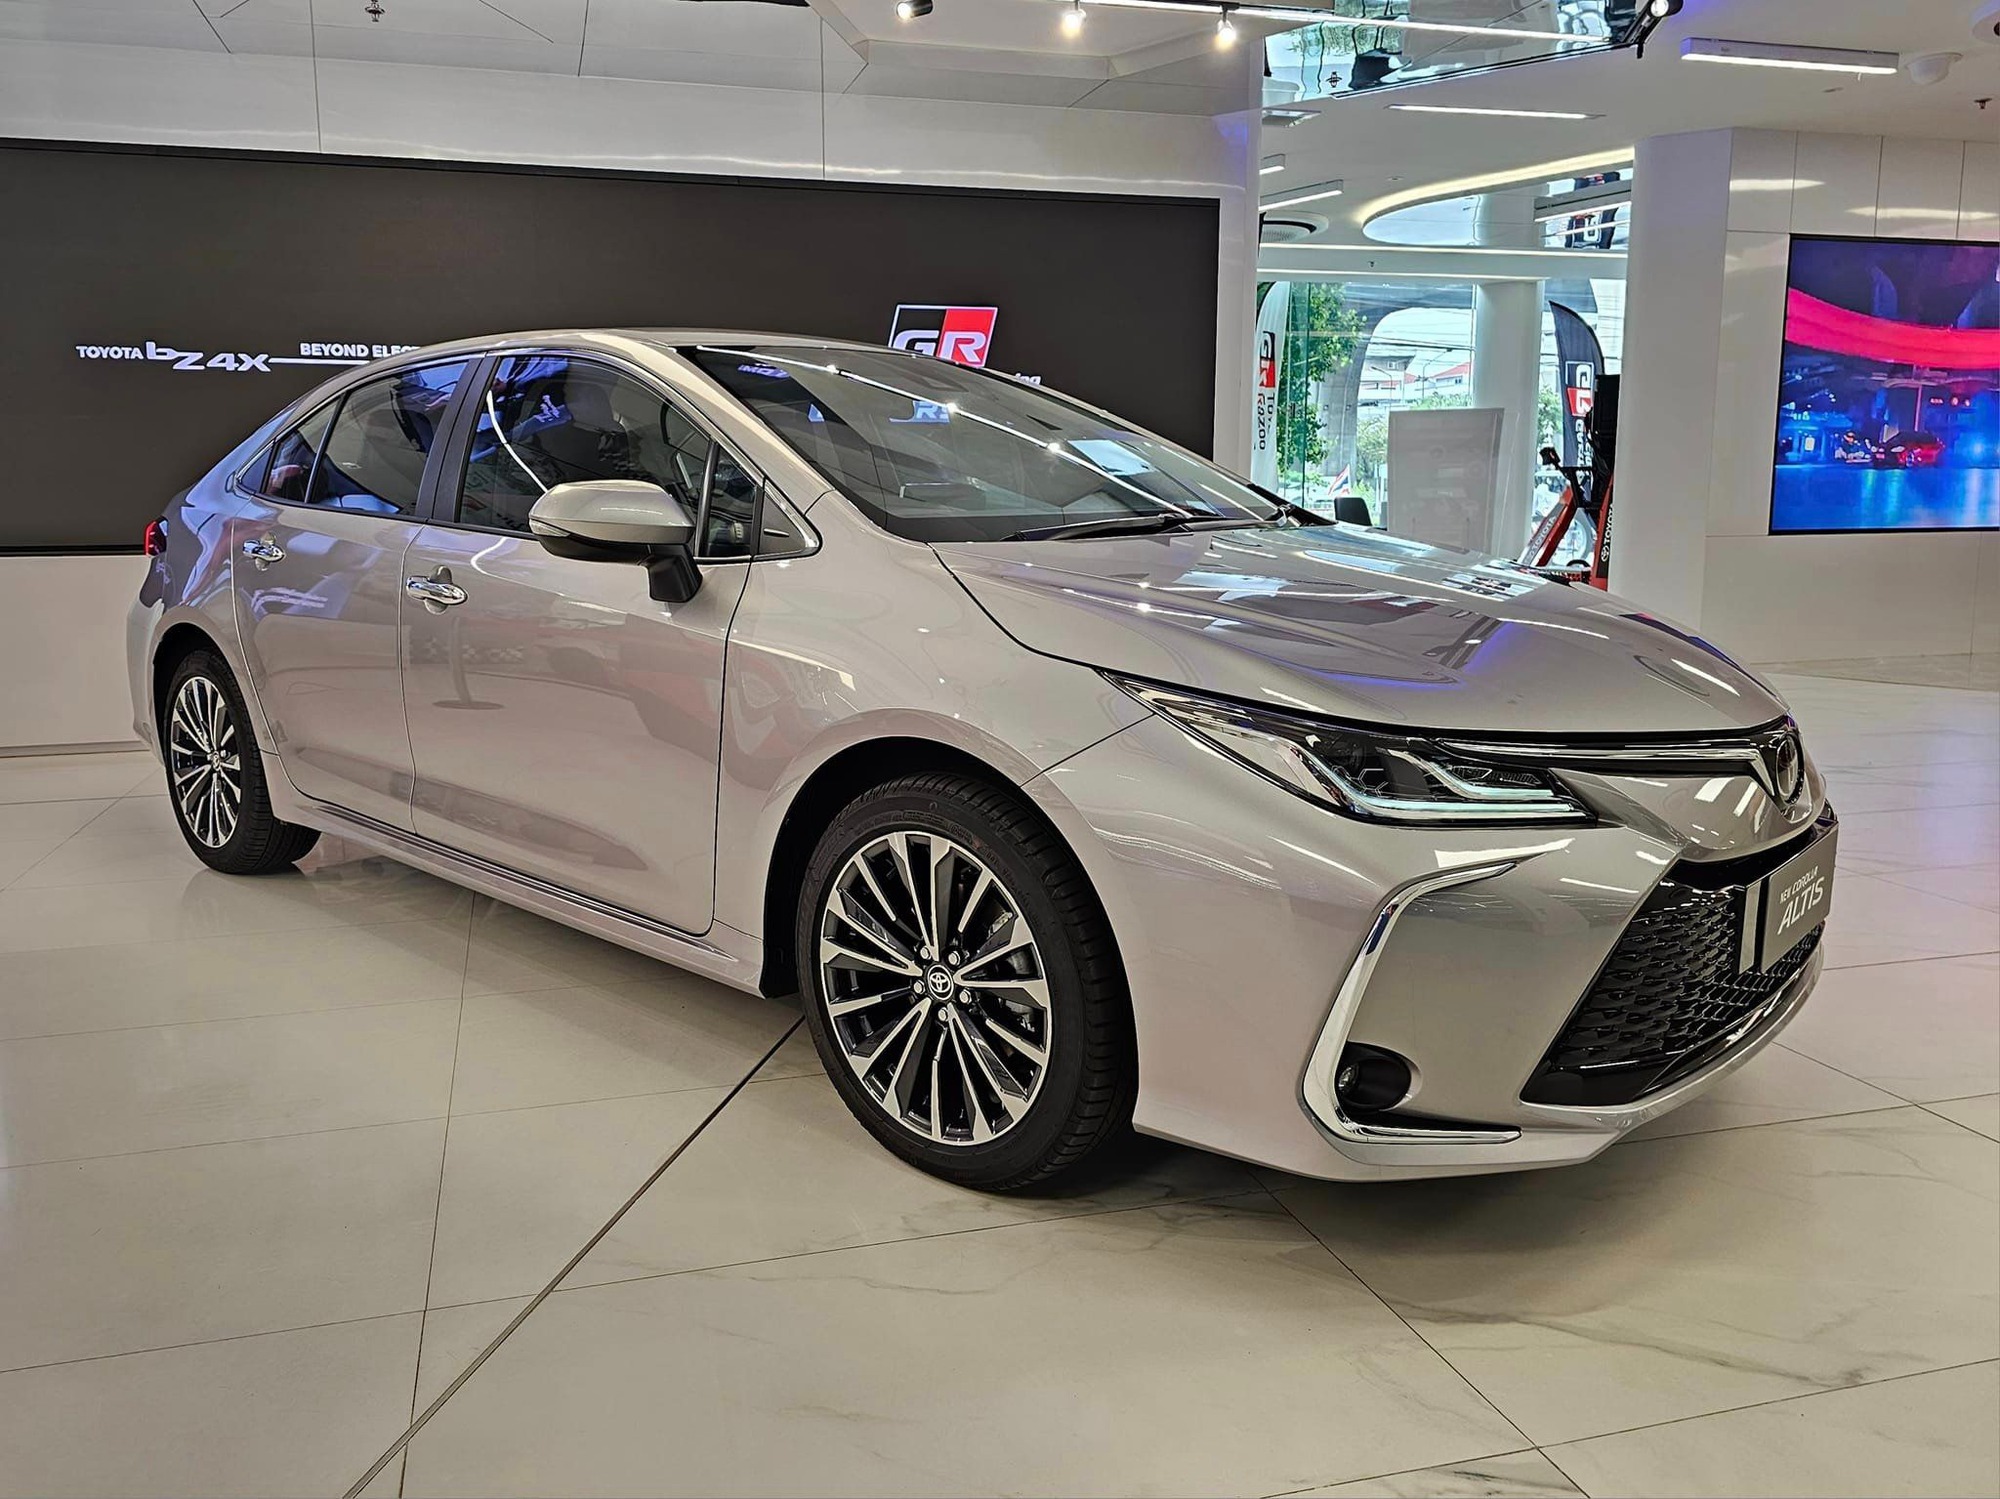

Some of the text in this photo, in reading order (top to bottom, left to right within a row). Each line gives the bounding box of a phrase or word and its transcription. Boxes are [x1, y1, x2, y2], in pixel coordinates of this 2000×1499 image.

[76, 345, 145, 360] TOYOTA
[300, 342, 369, 357] BEYOND
[372, 344, 420, 358] ELE
[1792, 865, 1818, 895] COROLLA
[1777, 876, 1825, 936] ALTIS
